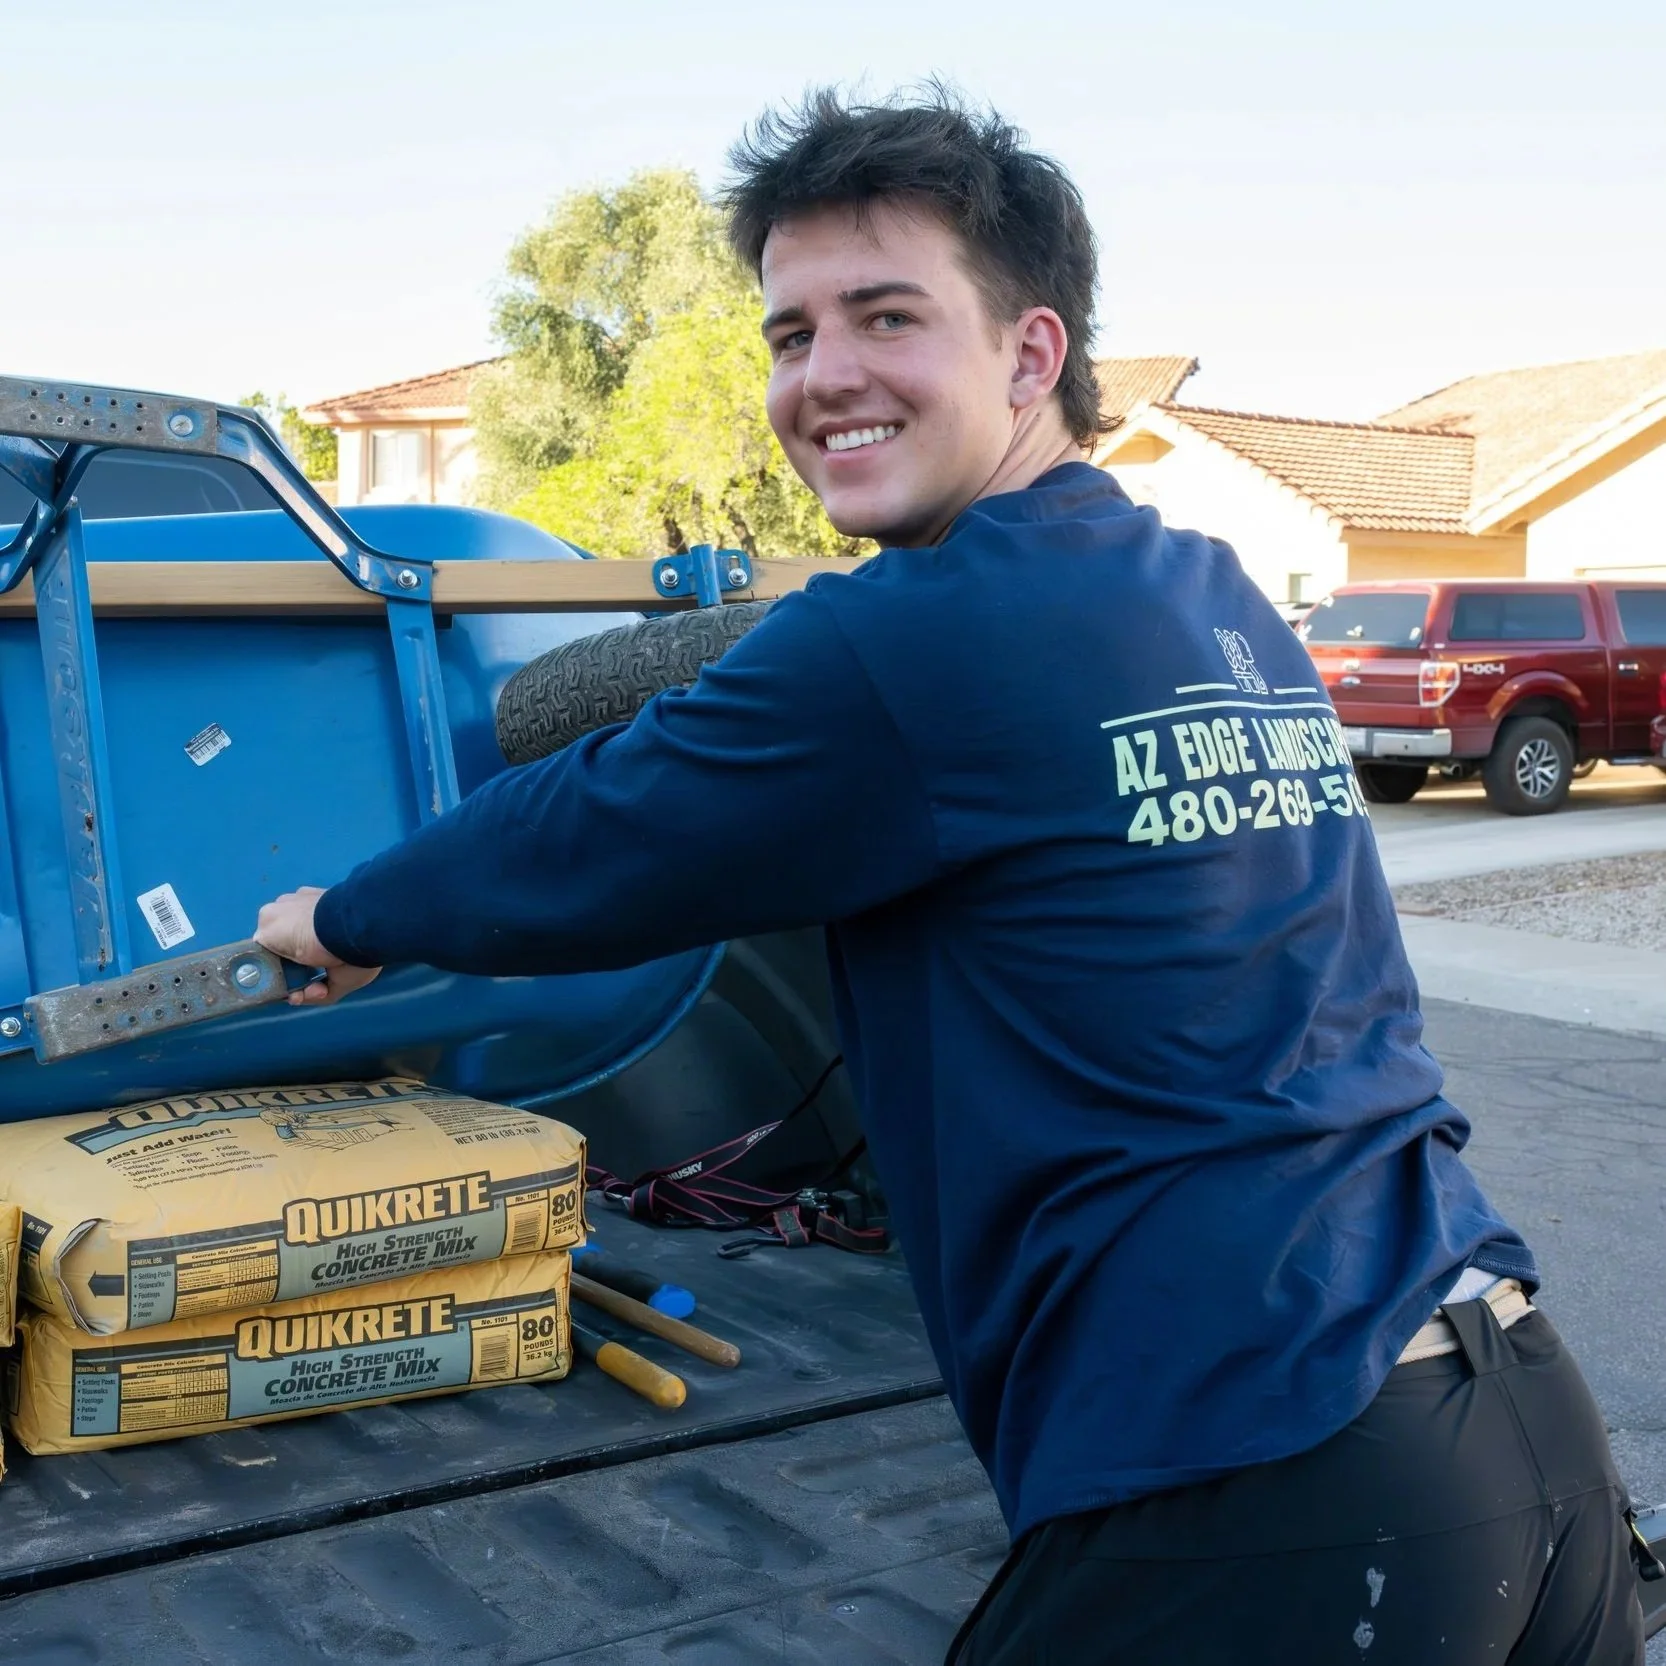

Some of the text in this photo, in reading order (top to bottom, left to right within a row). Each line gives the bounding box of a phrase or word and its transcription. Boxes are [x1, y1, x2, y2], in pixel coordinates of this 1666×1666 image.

[1112, 729, 1168, 797] AZ
[1171, 717, 1257, 781] EDGE
[1127, 774, 1371, 848] 480-269-50
[115, 1080, 425, 1129] QUIKRETE
[106, 1149, 138, 1164] Just
[143, 1139, 175, 1152] Add
[177, 1128, 232, 1143] Water!
[454, 1136, 475, 1145] NET
[475, 1133, 488, 1142] 80
[489, 1131, 499, 1140] lb
[667, 1161, 702, 1180] HUSKY
[285, 1174, 491, 1245] QUIKRETE
[527, 1192, 540, 1200] 1101
[551, 1188, 576, 1217] 80
[552, 1211, 576, 1226] POUNDS
[138, 1270, 172, 1280] Setting Posts
[310, 1245, 429, 1281] CONCRETE
[315, 1278, 344, 1289] Mezcla
[359, 1269, 395, 1280] Concreto
[409, 1262, 425, 1270] Alta
[427, 1253, 471, 1267] Resistencia
[237, 1297, 454, 1359] QUIKRETE
[494, 1316, 508, 1324] 1101
[522, 1315, 554, 1341] 80
[524, 1338, 554, 1351] POUNDS
[526, 1350, 553, 1361] 36.2 kg
[136, 1362, 163, 1370] Concrete
[264, 1365, 388, 1397] CONCRETE
[269, 1375, 436, 1405] Mezcla de Concreto de Alta Resistencia
